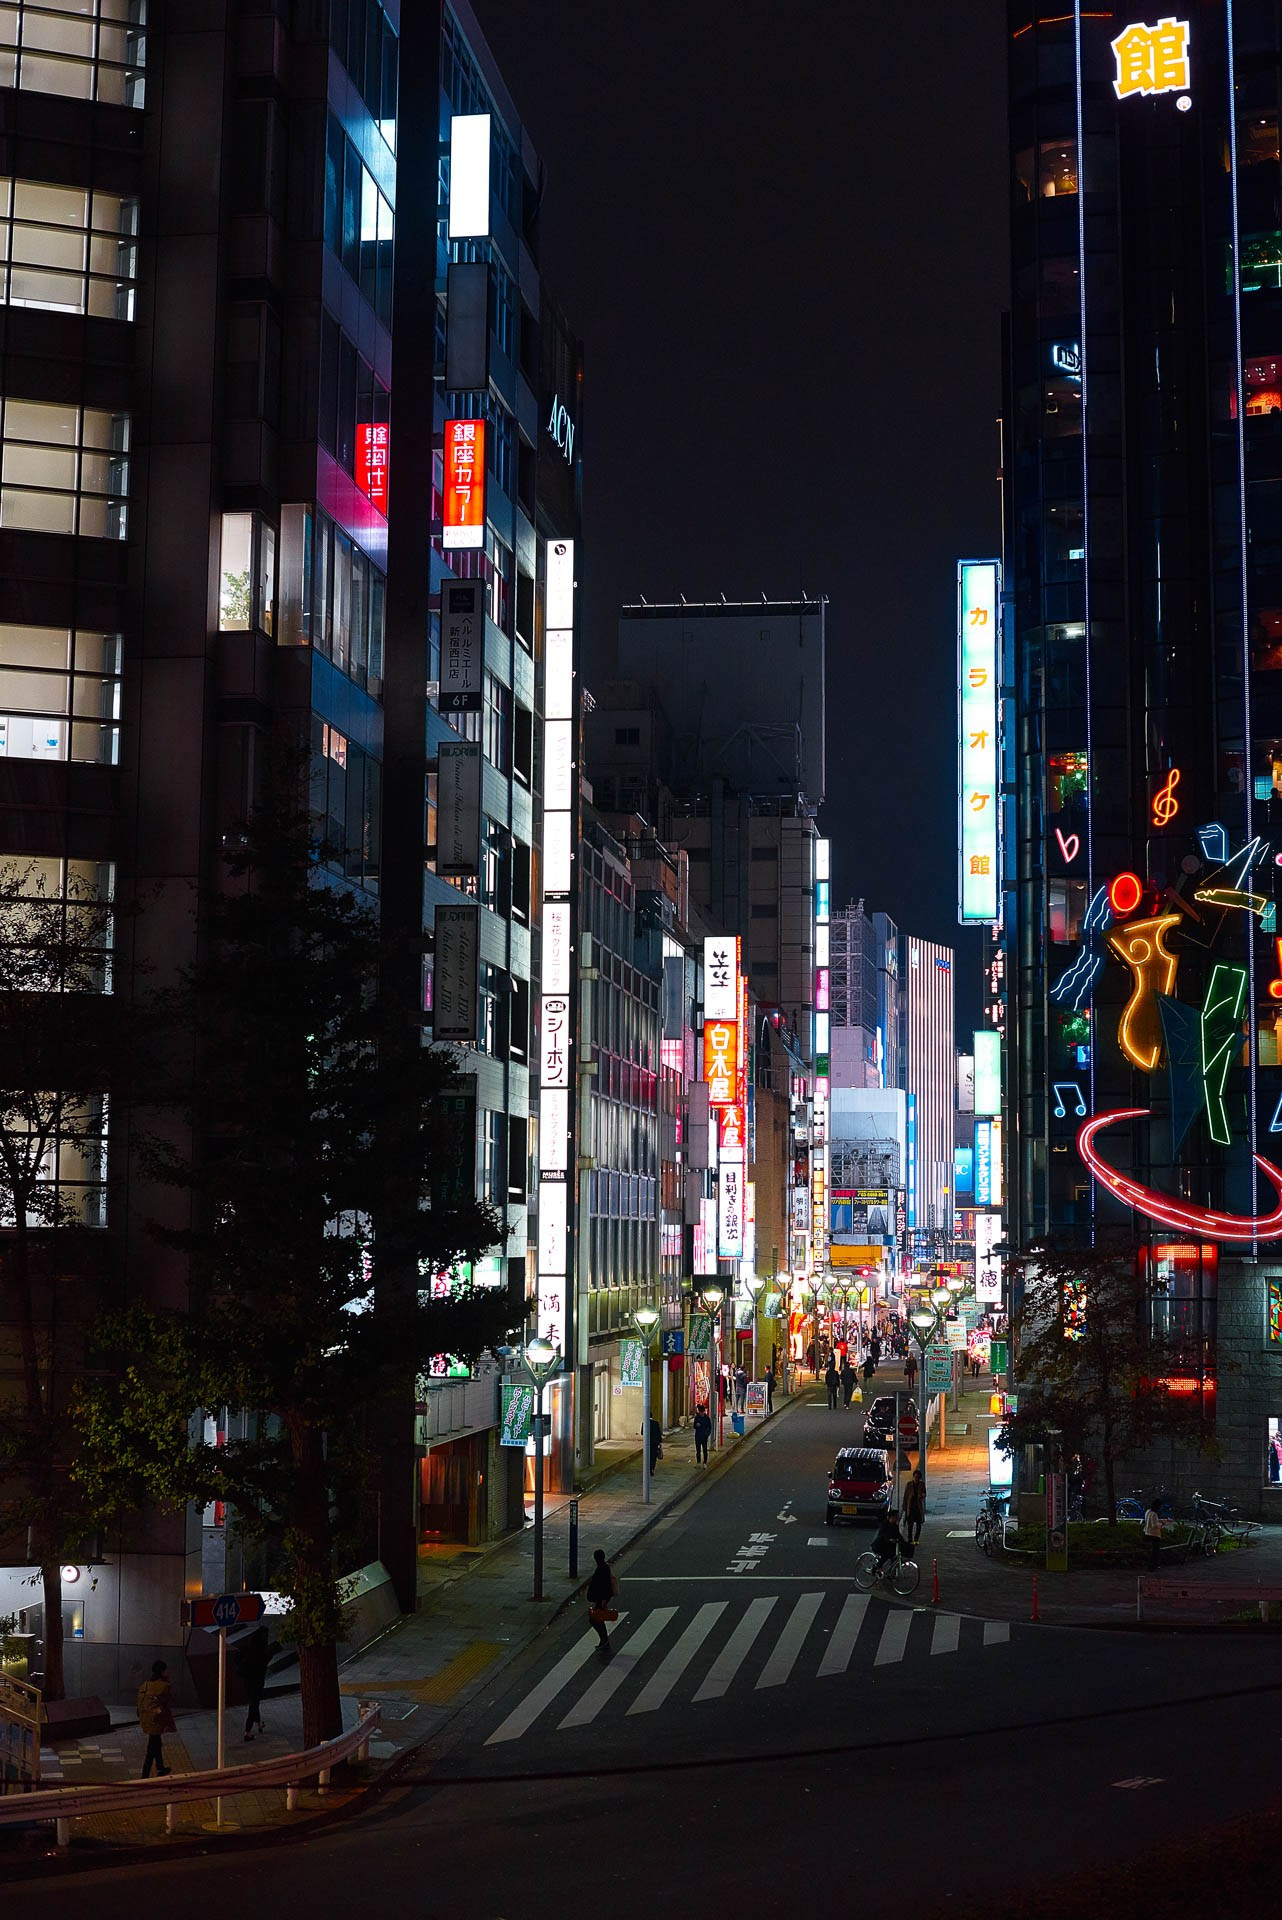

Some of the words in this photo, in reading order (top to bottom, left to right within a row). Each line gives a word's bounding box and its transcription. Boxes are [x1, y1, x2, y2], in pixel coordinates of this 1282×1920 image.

[1112, 17, 1190, 98] 館
[453, 423, 476, 522] 銀座カラー
[449, 626, 460, 679] 新宿西口店
[452, 695, 469, 706] 6F
[969, 606, 991, 875] カラオケ館
[551, 912, 562, 987] 桜花クリニック
[708, 1023, 733, 1103] 白木屋
[725, 1171, 739, 1240] 目利きの銀次
[216, 1602, 237, 1620] 414
